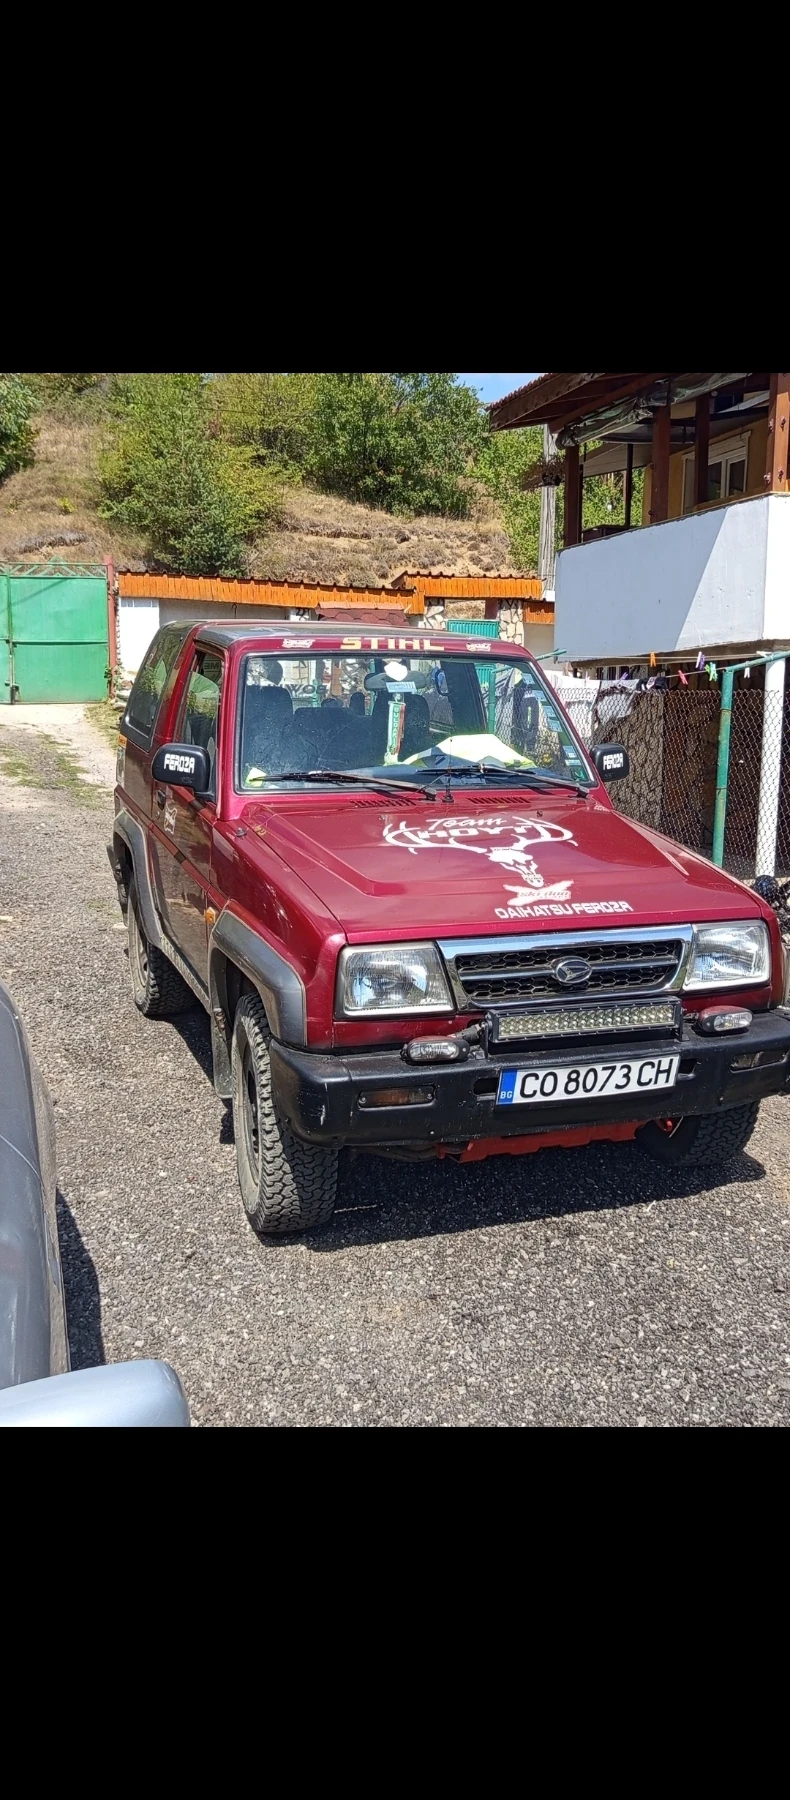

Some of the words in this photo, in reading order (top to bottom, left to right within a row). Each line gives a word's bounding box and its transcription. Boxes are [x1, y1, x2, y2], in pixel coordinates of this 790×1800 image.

[340, 636, 445, 651] STIHL
[163, 753, 195, 774] FEROZA
[425, 816, 507, 831] Team
[417, 826, 533, 839] HOYT
[494, 902, 573, 919] DAIHATSU
[571, 900, 635, 915] FEROZA
[500, 1090, 513, 1099] BG
[519, 1071, 558, 1099] CO
[563, 1064, 632, 1095] 8073
[636, 1057, 674, 1087] CH
